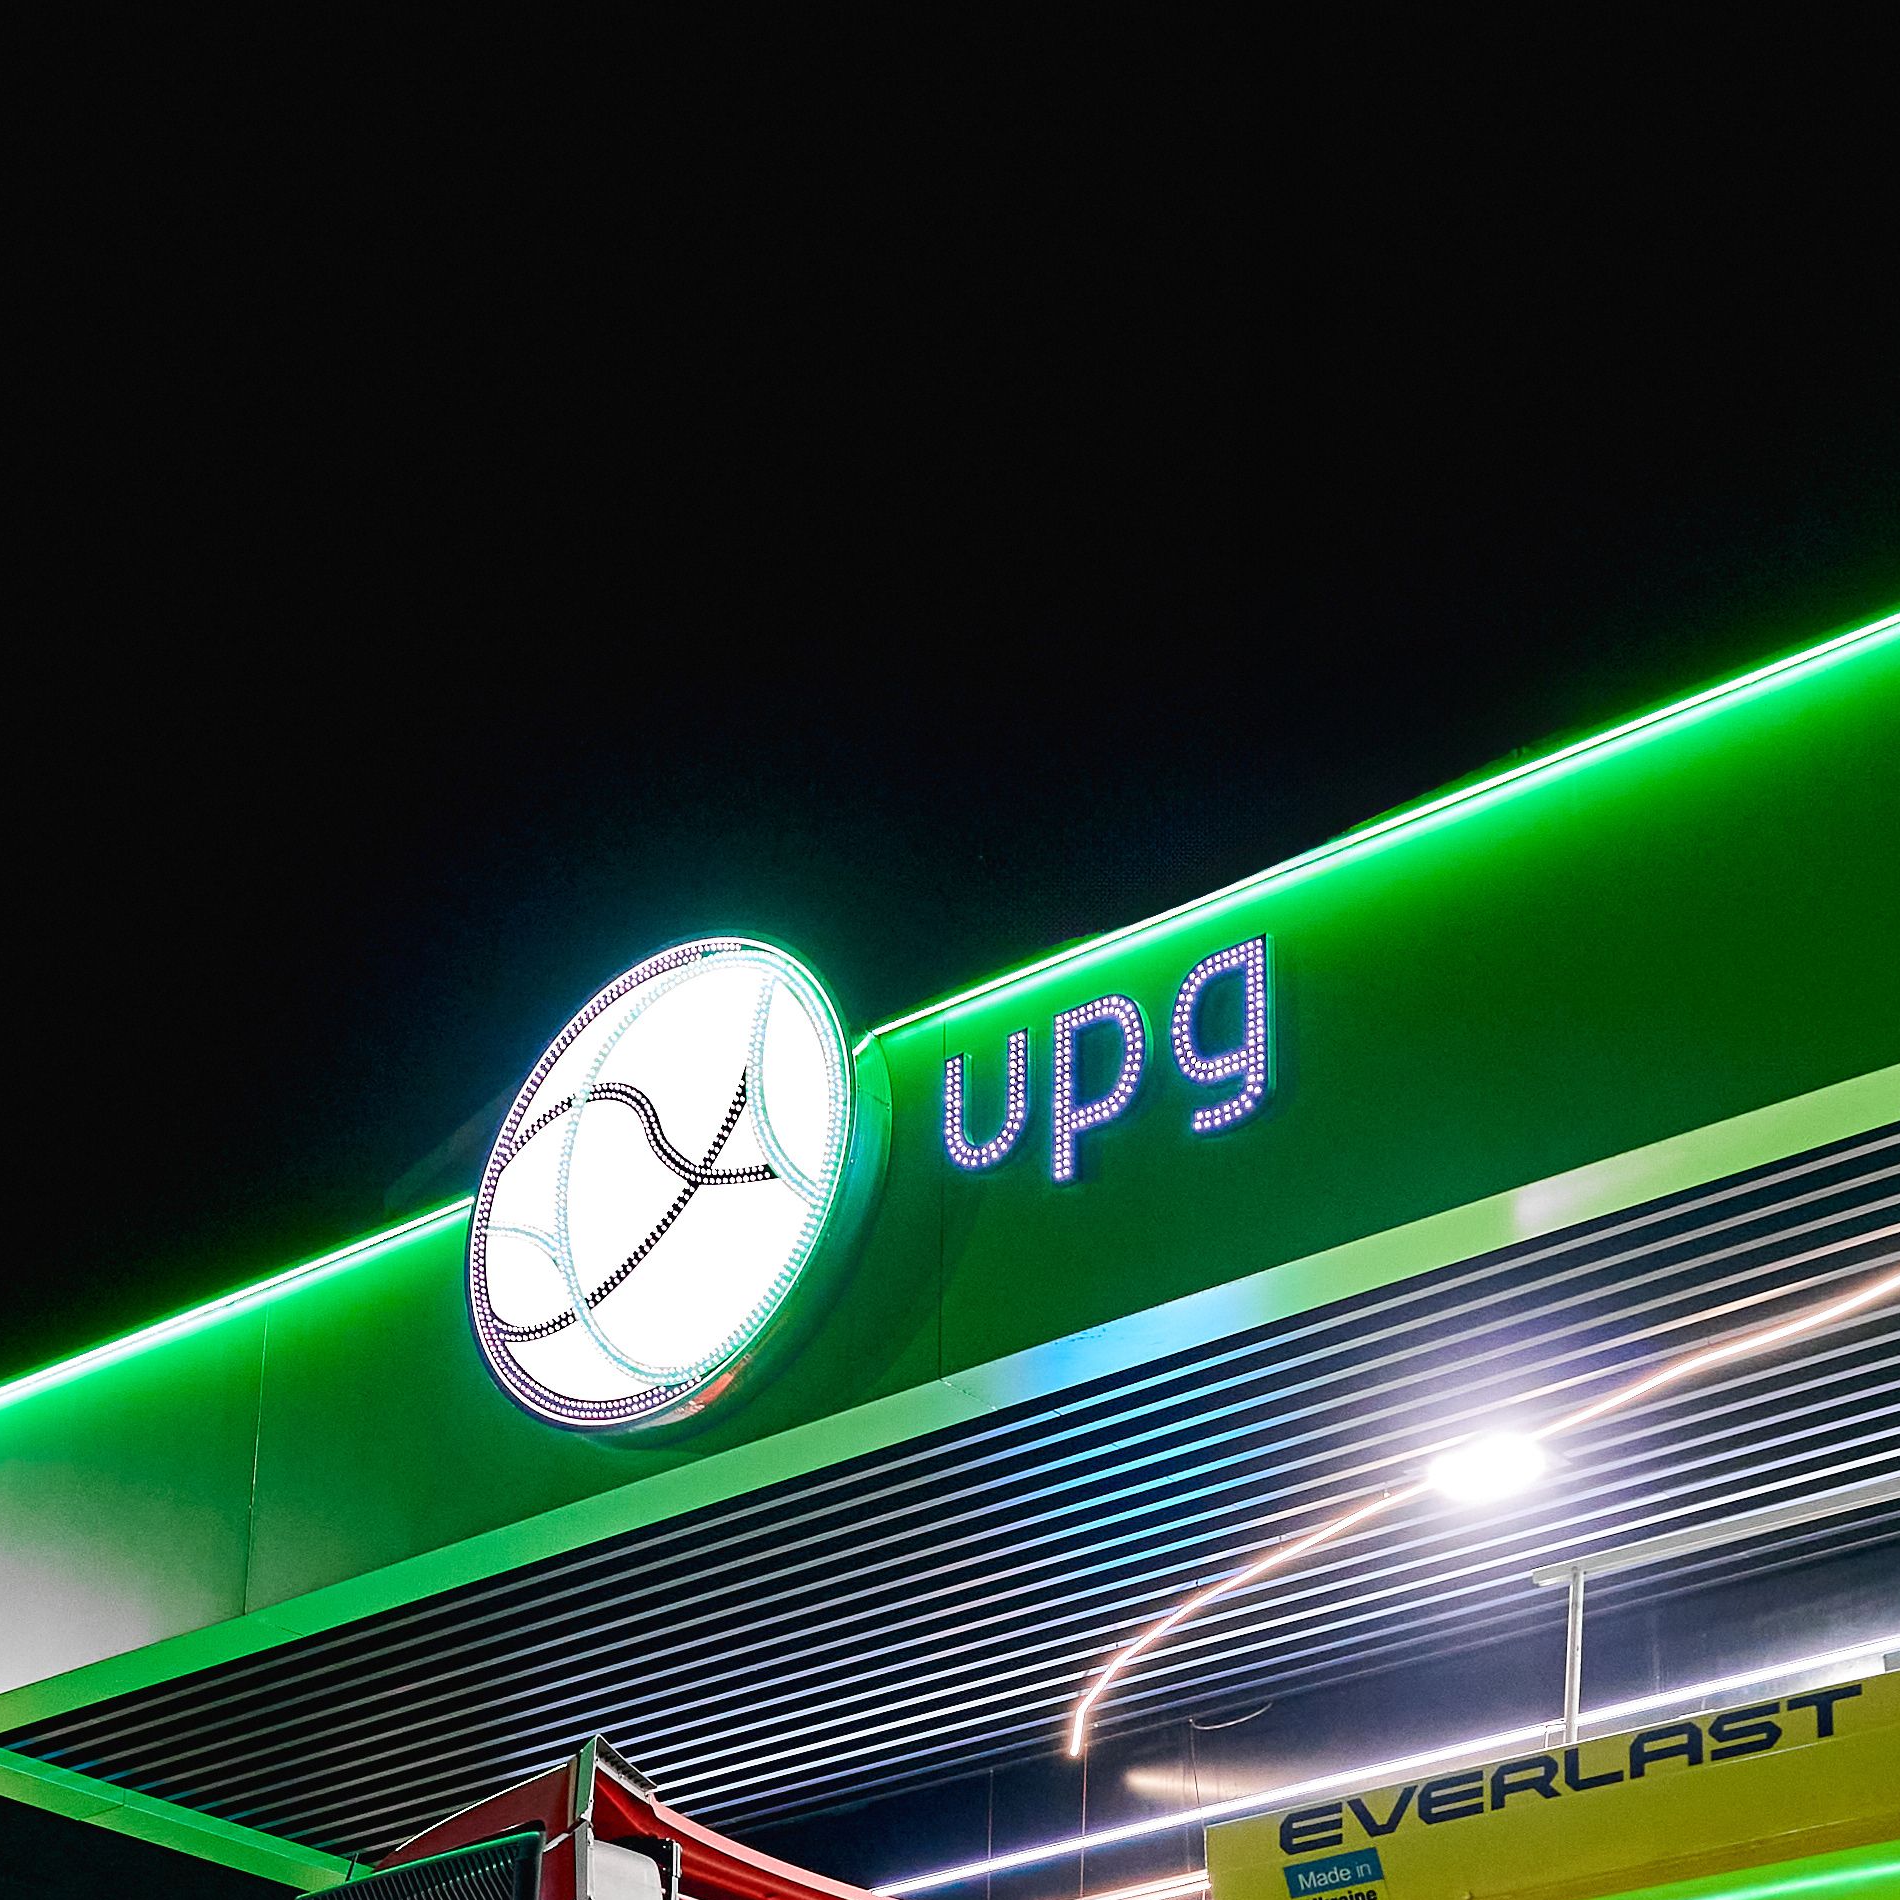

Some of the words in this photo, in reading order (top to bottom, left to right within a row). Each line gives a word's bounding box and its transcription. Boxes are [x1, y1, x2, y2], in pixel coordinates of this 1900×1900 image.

[944, 933, 1268, 1184] upg
[1279, 1684, 1862, 1855] EVERLAST
[1298, 1866, 1351, 1890] Made
[1355, 1862, 1372, 1878] in
